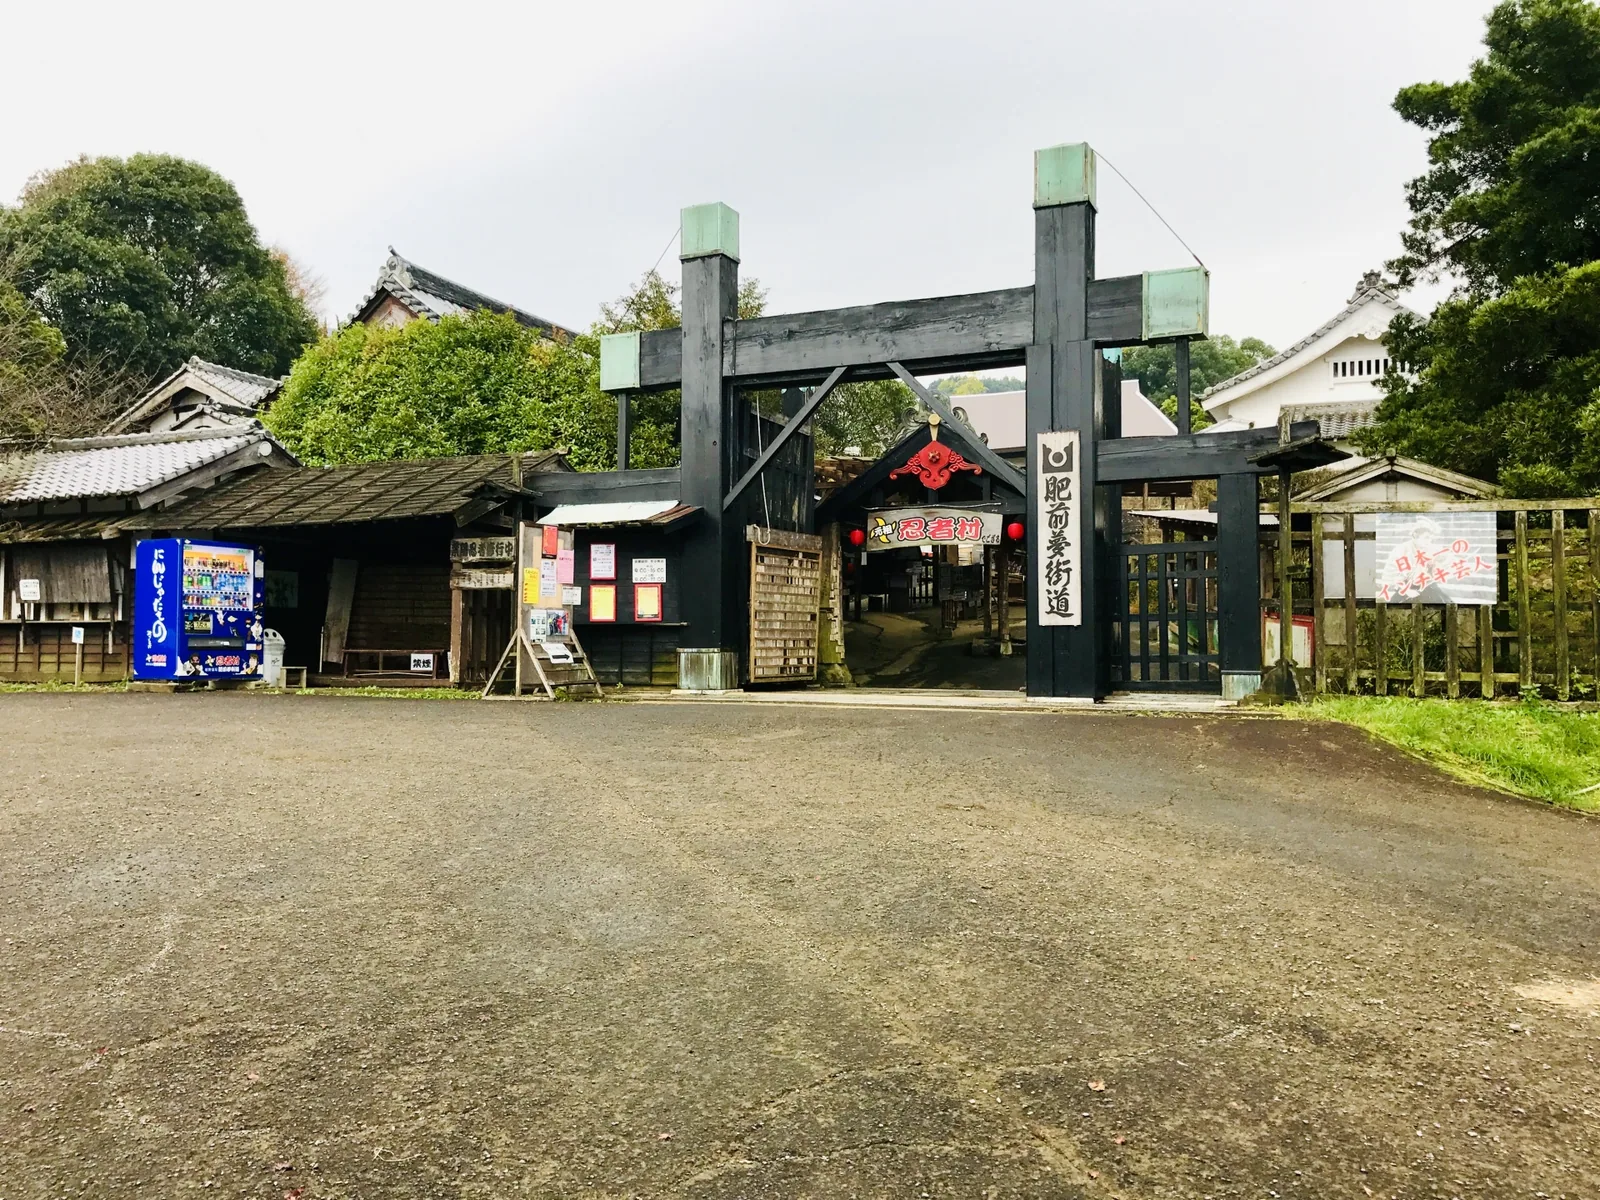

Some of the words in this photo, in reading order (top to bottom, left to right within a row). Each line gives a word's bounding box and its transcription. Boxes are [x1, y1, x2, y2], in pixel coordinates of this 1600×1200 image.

[874, 524, 893, 537] 元祖
[897, 517, 983, 541] 忍者村
[1044, 475, 1075, 618] 肥前夢街道
[1395, 539, 1469, 572] 日本一の
[1379, 556, 1493, 601] インチキ芸人
[412, 658, 432, 669] 禁煙
